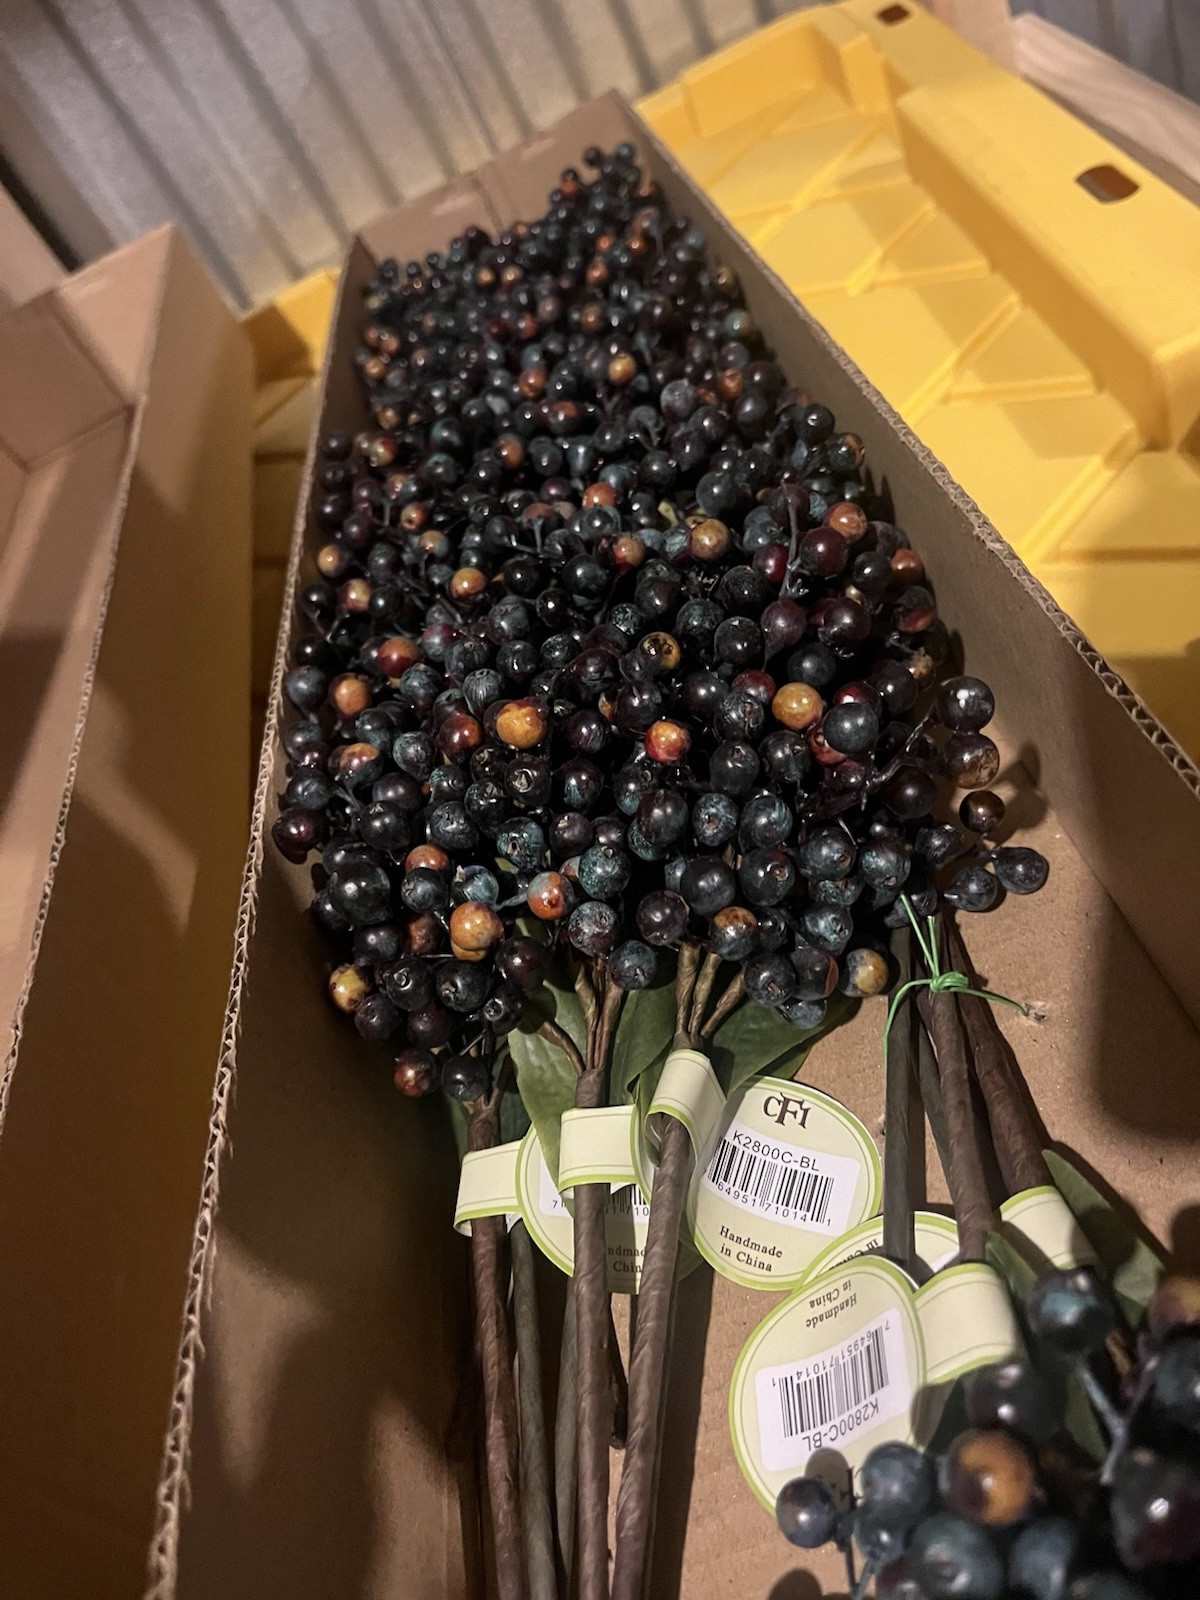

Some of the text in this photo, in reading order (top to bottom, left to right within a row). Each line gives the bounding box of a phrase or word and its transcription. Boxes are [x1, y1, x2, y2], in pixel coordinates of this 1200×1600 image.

[732, 1130, 820, 1171] K2800C-BL
[717, 1181, 832, 1227] 64951 71014 1
[719, 1225, 783, 1258] Handmade
[720, 1243, 773, 1272] in China
[613, 1261, 642, 1274] Chin
[805, 1292, 857, 1329] Handmade
[809, 1280, 852, 1309] in China
[771, 1319, 891, 1387] 7 64951 71014 1
[802, 1398, 879, 1451] K2800C-BL
